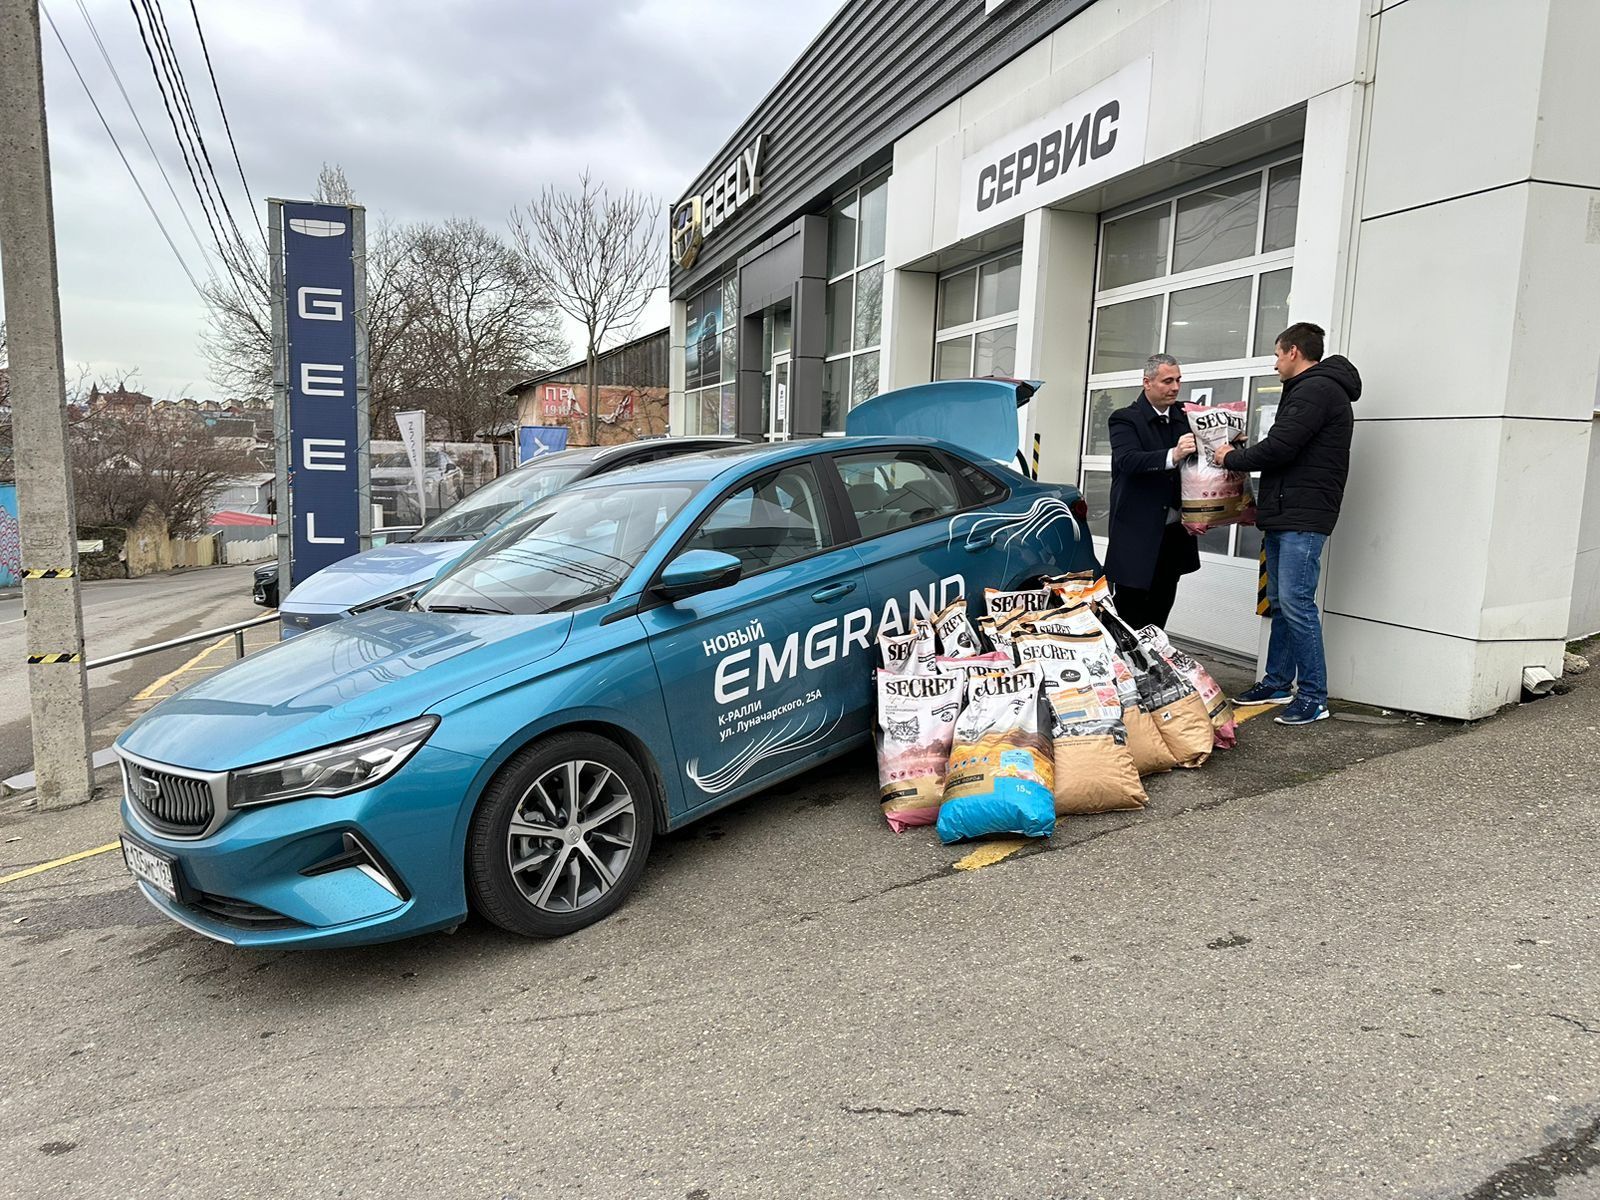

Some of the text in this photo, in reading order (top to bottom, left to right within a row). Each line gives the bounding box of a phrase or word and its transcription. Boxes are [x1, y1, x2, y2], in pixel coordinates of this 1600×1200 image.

[976, 99, 1120, 213] СЕРВИС
[701, 134, 768, 238] GEELY
[297, 286, 347, 544] GEEL
[990, 593, 1048, 614] SECRE
[702, 618, 765, 657] НОВЫЙ
[714, 574, 966, 705] EMGRAND
[942, 612, 965, 640] RET
[1023, 643, 1077, 661] SECRET
[885, 677, 957, 699] SECRET
[718, 700, 762, 726] К-РАЛЛИ
[719, 689, 823, 742] ул. Луначарского, 25А
[1016, 784, 1026, 793] 15
